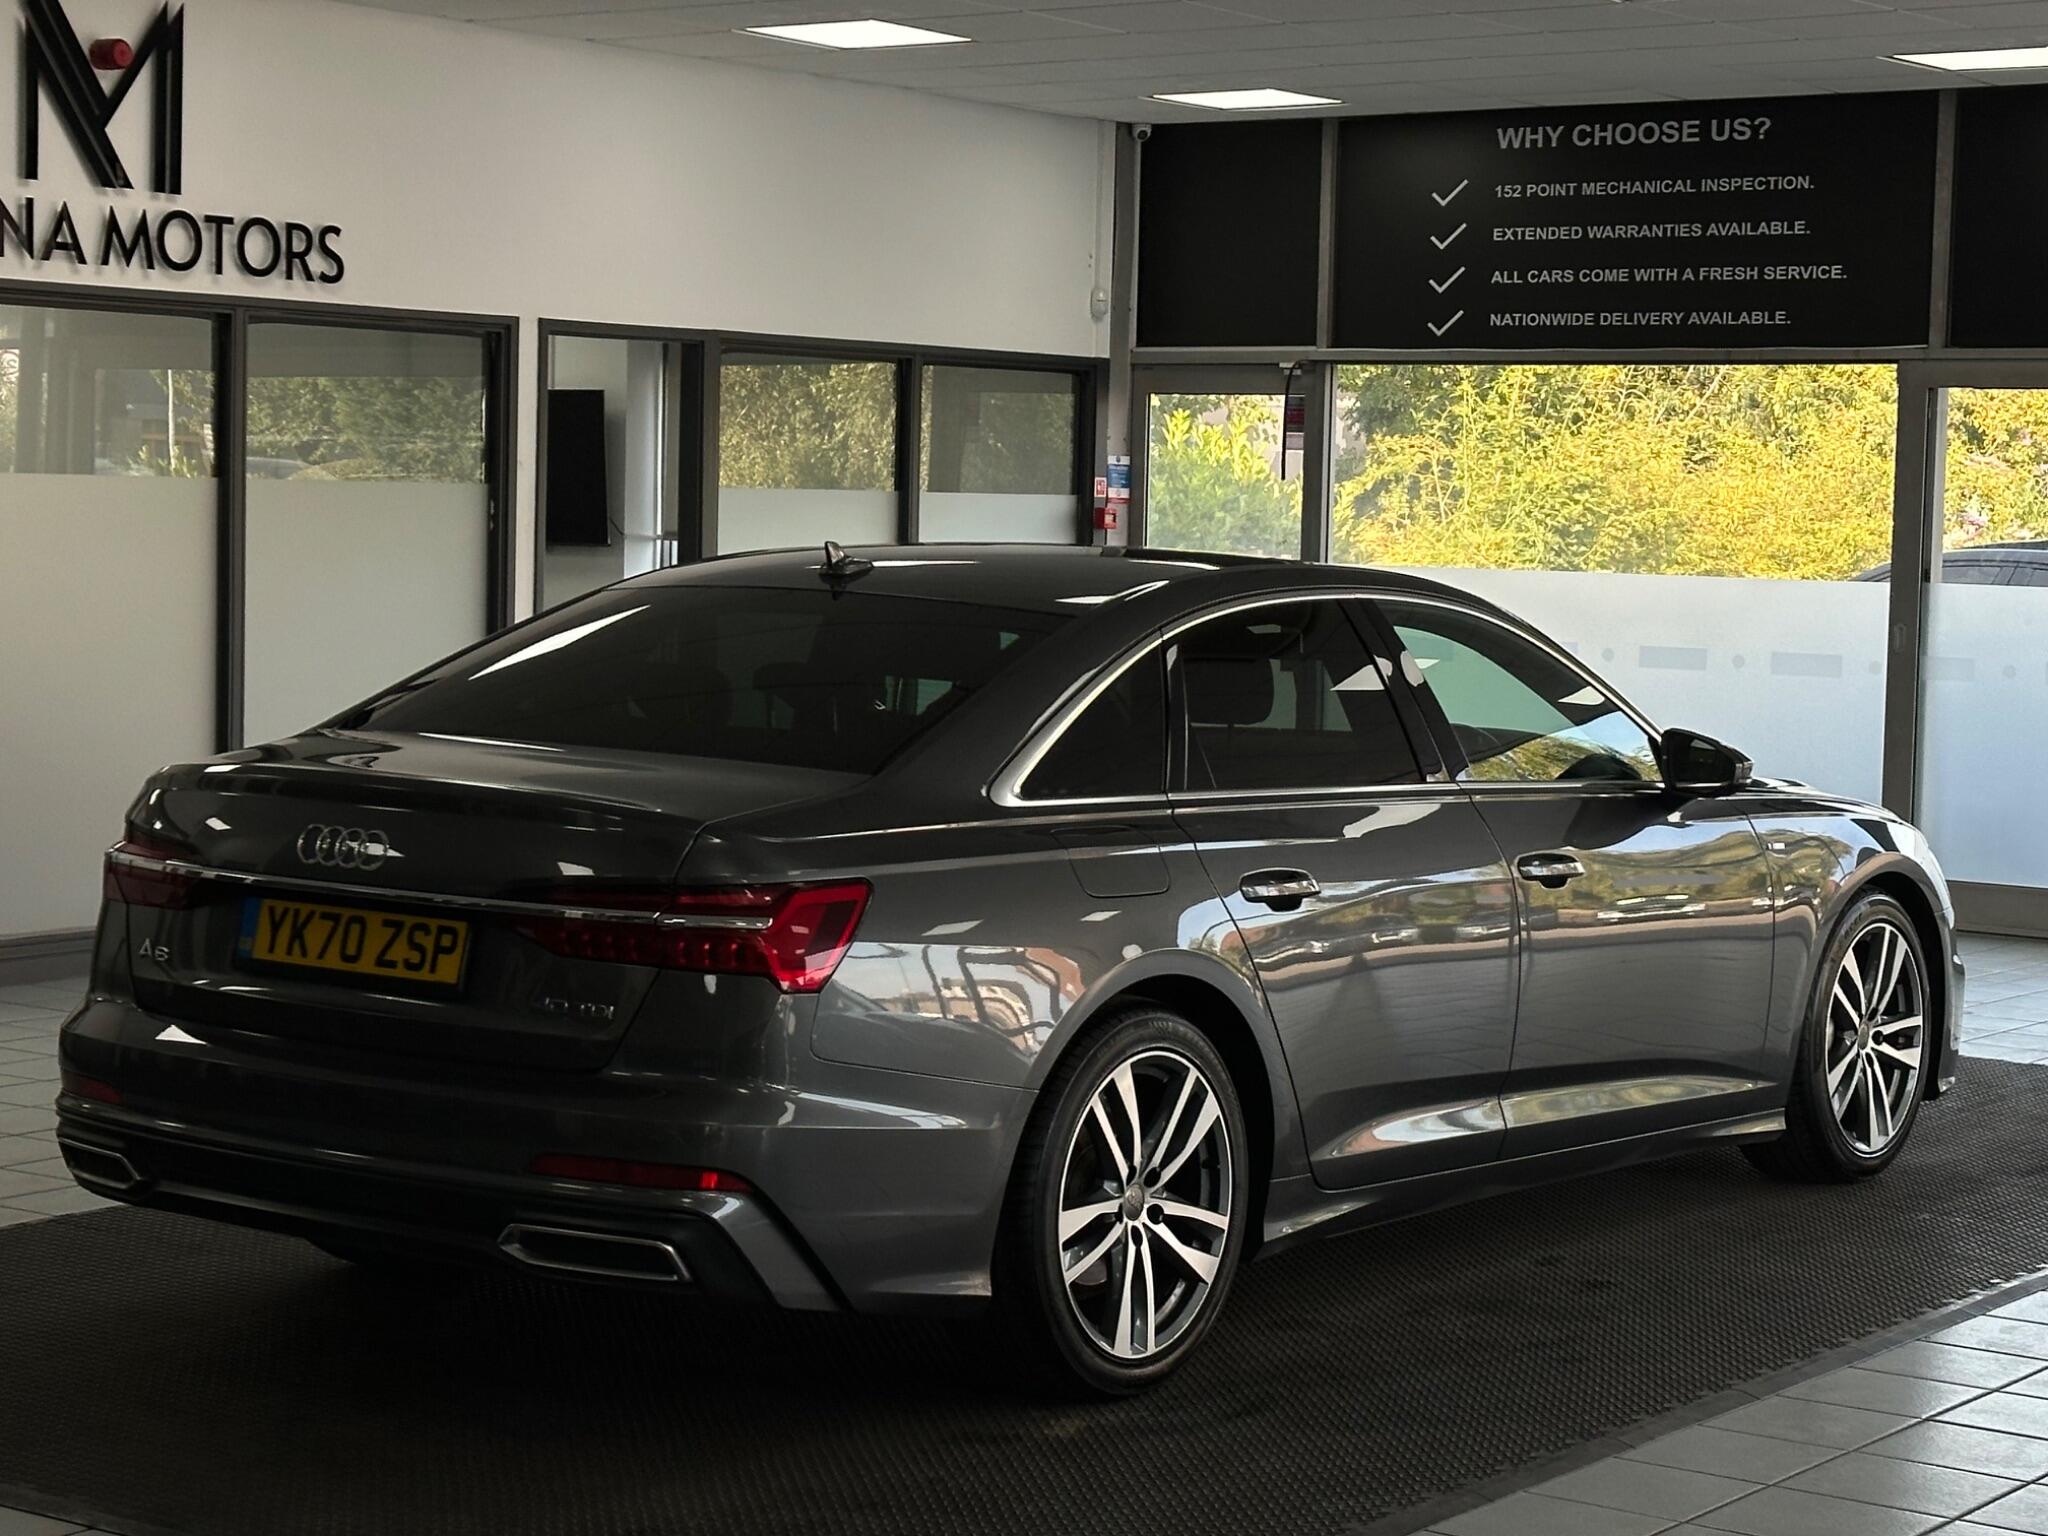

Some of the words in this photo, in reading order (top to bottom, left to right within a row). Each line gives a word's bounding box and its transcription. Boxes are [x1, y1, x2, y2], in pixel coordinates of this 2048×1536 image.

[1496, 125, 1564, 149] WHY
[1572, 120, 1700, 147] CHOOSE
[1711, 117, 1771, 142] US?
[1494, 184, 1522, 198] 152
[1526, 182, 1578, 198] POINT
[1581, 179, 1697, 196] MECHANICAL
[1701, 175, 1815, 192] INSPECTION.
[1492, 226, 1583, 241] EXTENDED
[1586, 223, 1702, 239] WARRANTIES
[1705, 220, 1811, 237] AVAILABLE.
[101, 205, 345, 284] MOTORS
[1490, 270, 1523, 284] ALL
[1527, 269, 1574, 284] CARS
[1578, 268, 1630, 283] COME
[1633, 267, 1678, 282] WITH
[1681, 267, 1695, 281] A
[1699, 266, 1759, 281] FRESH
[1763, 265, 1848, 280] SERVICE.
[1489, 312, 1595, 327] NATIONWIDE
[1599, 311, 1685, 326] DELIVERY
[1687, 310, 1791, 325] AVAILABLE.
[138, 937, 170, 962] A6
[266, 905, 368, 965] YK70
[374, 917, 460, 975] ZSP
